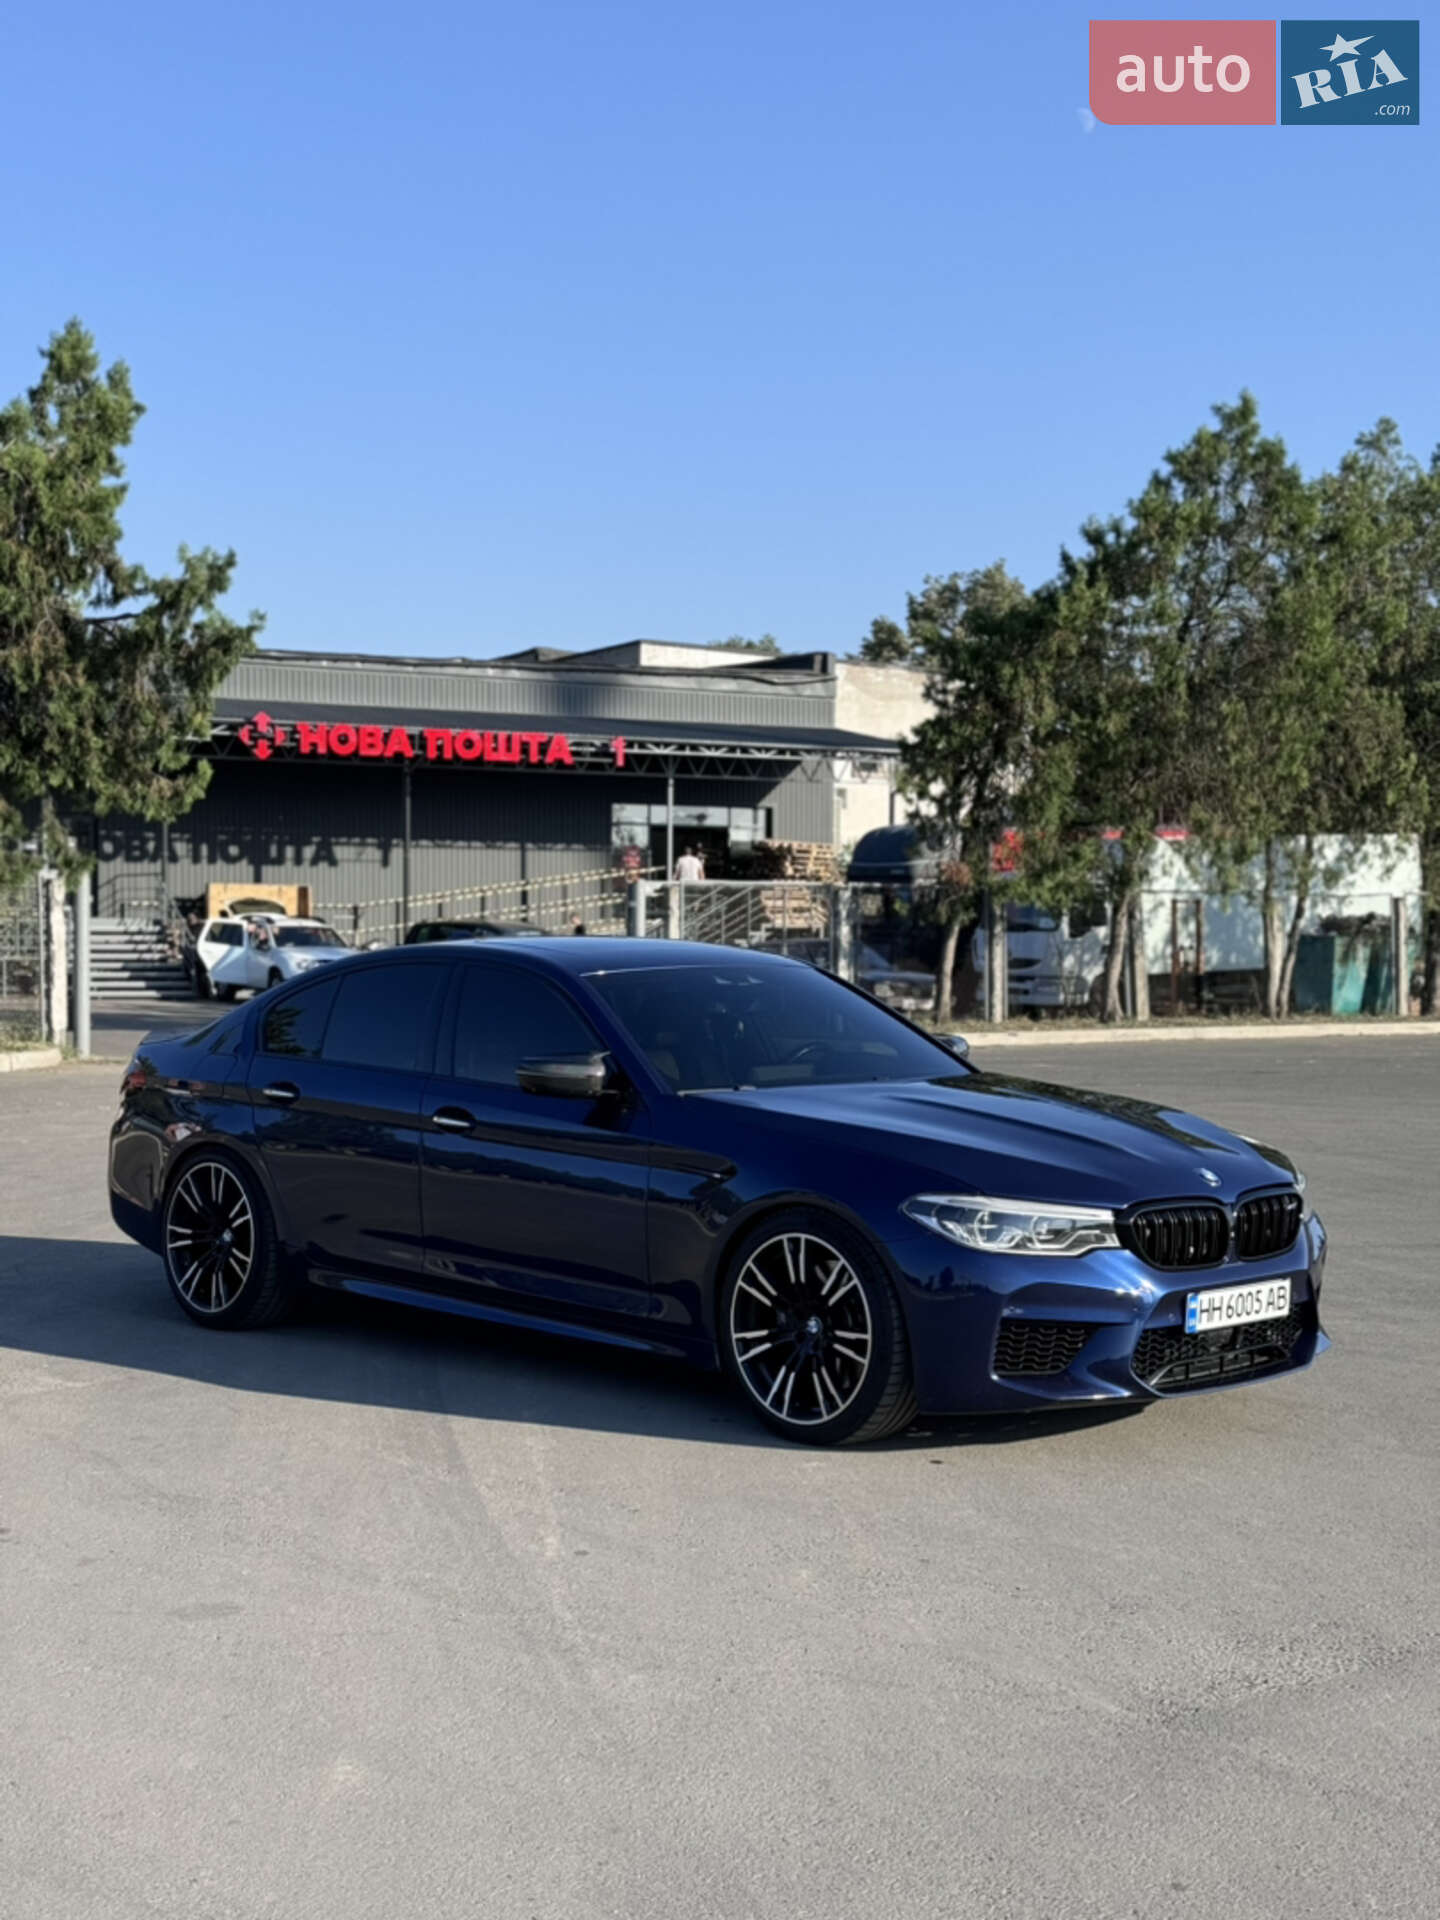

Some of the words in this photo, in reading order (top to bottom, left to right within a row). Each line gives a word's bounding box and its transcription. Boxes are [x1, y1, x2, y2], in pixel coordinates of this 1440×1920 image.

[297, 722, 413, 758] НОВА
[423, 728, 574, 764] ПОШТА
[1199, 1295, 1224, 1324] HH
[1226, 1289, 1263, 1319] 6005
[1265, 1285, 1288, 1313] AB
